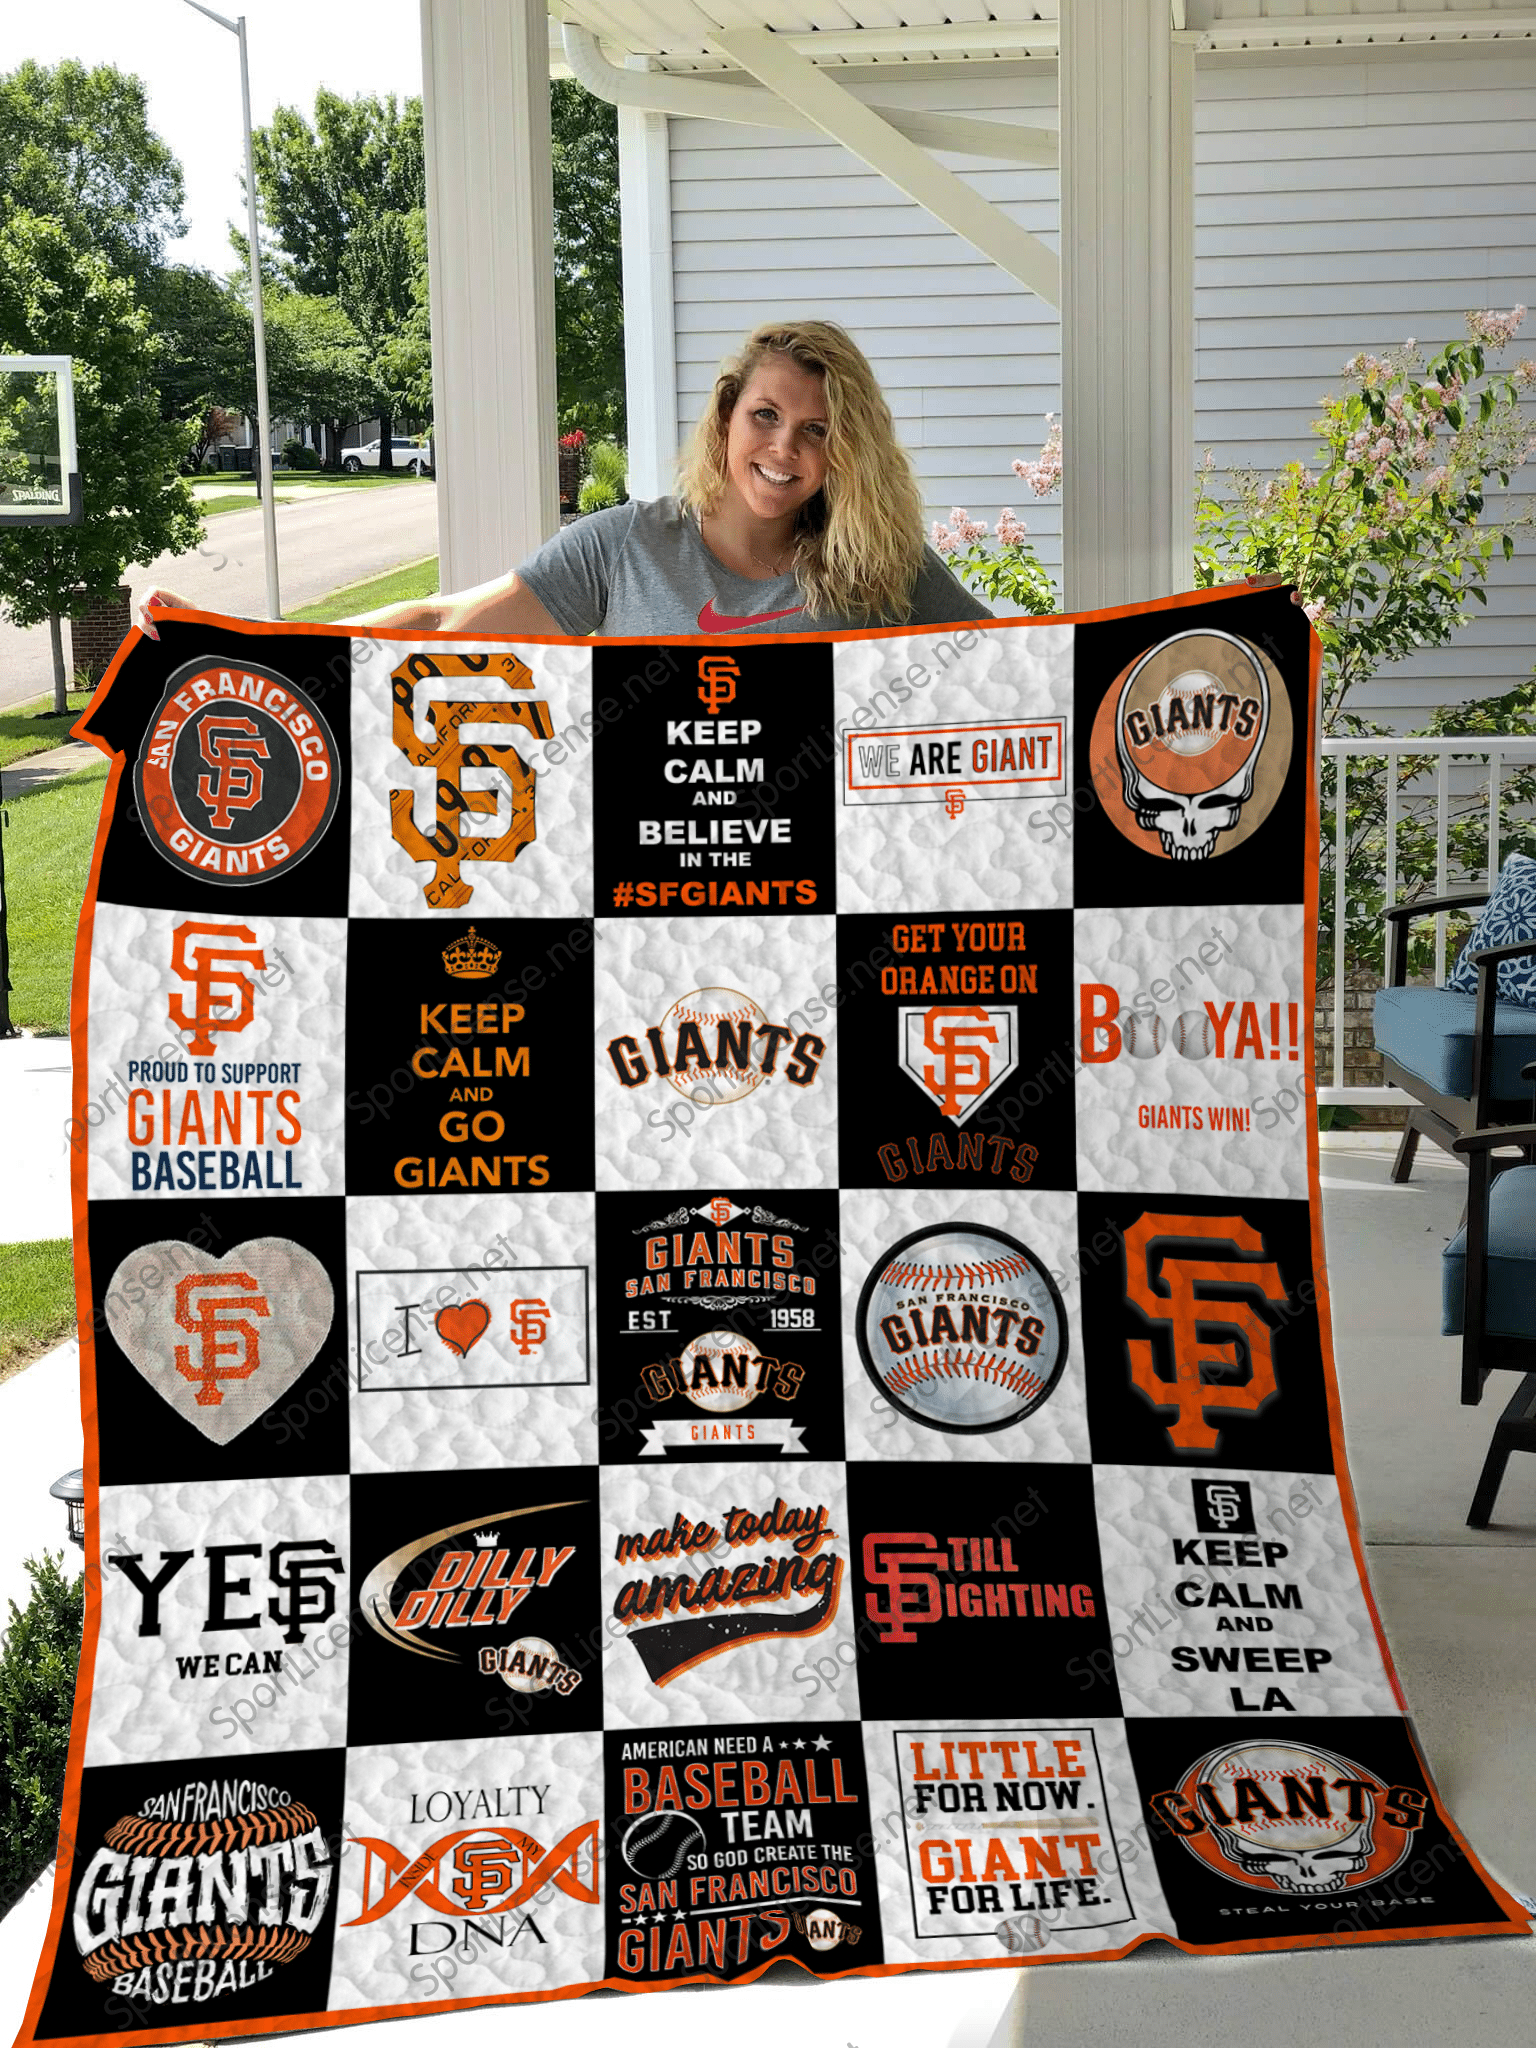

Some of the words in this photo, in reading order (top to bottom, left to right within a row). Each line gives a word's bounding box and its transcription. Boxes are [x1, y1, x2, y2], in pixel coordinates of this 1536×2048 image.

[12, 489, 61, 502] SPALDING
[697, 655, 741, 714] SF
[147, 720, 179, 769] SAN
[173, 672, 328, 781] FRANCISCO
[667, 720, 762, 745] KEEP
[1125, 692, 1261, 749] GIANTS
[664, 758, 764, 783] CALM
[859, 745, 900, 778] WE
[909, 741, 961, 776] ARE
[972, 736, 1052, 773] GIANT
[692, 791, 737, 806] AND
[169, 828, 290, 873] GIANTS
[639, 818, 791, 845] BELIEVE
[680, 852, 702, 867] IN
[709, 851, 752, 867] THE
[613, 879, 817, 907] #SFGIANTS
[892, 924, 945, 953] GET
[951, 922, 1026, 952] YOUR
[168, 920, 267, 1056] SF
[881, 965, 995, 995] ORANGE
[1000, 964, 1038, 994] ON
[420, 1003, 525, 1034] KEEP
[129, 1060, 188, 1082] PROUD
[194, 1062, 216, 1083] TO
[222, 1062, 302, 1084] SUPPORT
[412, 1047, 530, 1079] CALM
[606, 1020, 826, 1088] GIANTS
[923, 1005, 999, 1116] SF
[449, 1087, 493, 1102] AND
[127, 1088, 302, 1147] GIANTS
[439, 1110, 505, 1142] GO
[1138, 1104, 1203, 1130] GIANTS
[1207, 1107, 1250, 1132] WIN!
[132, 1150, 302, 1191] BASEBALL
[394, 1154, 550, 1188] GIANTS
[877, 1132, 1039, 1183] GIANTS
[645, 1231, 794, 1270] GIANTS
[625, 1273, 671, 1298] SAN
[684, 1269, 816, 1296] FRANCISCO
[896, 1295, 928, 1311] SAN
[935, 1293, 1031, 1312] FRANCISCO
[394, 1304, 422, 1358] I
[628, 1310, 672, 1330] EST
[770, 1308, 815, 1329] 1958
[879, 1304, 1047, 1358] GIANTS
[1122, 1210, 1290, 1450] SF
[174, 1271, 272, 1406] SF
[640, 1353, 805, 1402] GIANTS
[691, 1424, 755, 1441] GIANTS
[615, 1512, 721, 1566] make
[722, 1497, 839, 1558] today
[428, 1546, 576, 1591] DILLY
[1172, 1538, 1289, 1568] KEEP
[394, 1587, 531, 1630] DILLY
[613, 1552, 845, 1640] amazing
[1174, 1581, 1303, 1610] CALM
[1216, 1616, 1274, 1632] AND
[176, 1653, 220, 1679] WE
[225, 1650, 283, 1676] CAN
[478, 1646, 583, 1696] GIANTS
[1171, 1646, 1332, 1673] SWEEP
[1230, 1687, 1297, 1712] LA
[621, 1738, 708, 1761] AMERICAN
[714, 1736, 757, 1755] NEED
[762, 1735, 774, 1753] A
[910, 1740, 1086, 1781] LITTLE
[138, 1788, 182, 1821] SAN
[181, 1779, 292, 1822] FRANCISCO
[410, 1785, 551, 1824] LOYALTY
[624, 1758, 858, 1815] BASEBALL
[914, 1782, 987, 1814] FOR
[993, 1781, 1096, 1812] NOW.
[721, 1808, 814, 1843] TEAM
[1149, 1776, 1428, 1838] GIANTS
[516, 1836, 541, 1857] MY
[687, 1853, 708, 1871] SO
[713, 1850, 747, 1868] GOD
[754, 1844, 818, 1863] CREATE
[821, 1844, 853, 1862] THE
[918, 1833, 1101, 1883] GIANT
[399, 1851, 439, 1889] INSIDE
[72, 1826, 333, 1957] GIANTS
[619, 1879, 678, 1914] SAN
[690, 1865, 857, 1906] FRANCISCO
[926, 1885, 1004, 1914] FOR
[1009, 1878, 1112, 1911] LIFE.
[1218, 1904, 1290, 1916] STEAL
[1299, 1900, 1360, 1912] YOUR
[1371, 1895, 1436, 1908] BASE
[409, 1913, 549, 1956] DNA
[617, 1909, 791, 1974] GIANTS
[111, 1959, 274, 2004] BASEBALL
